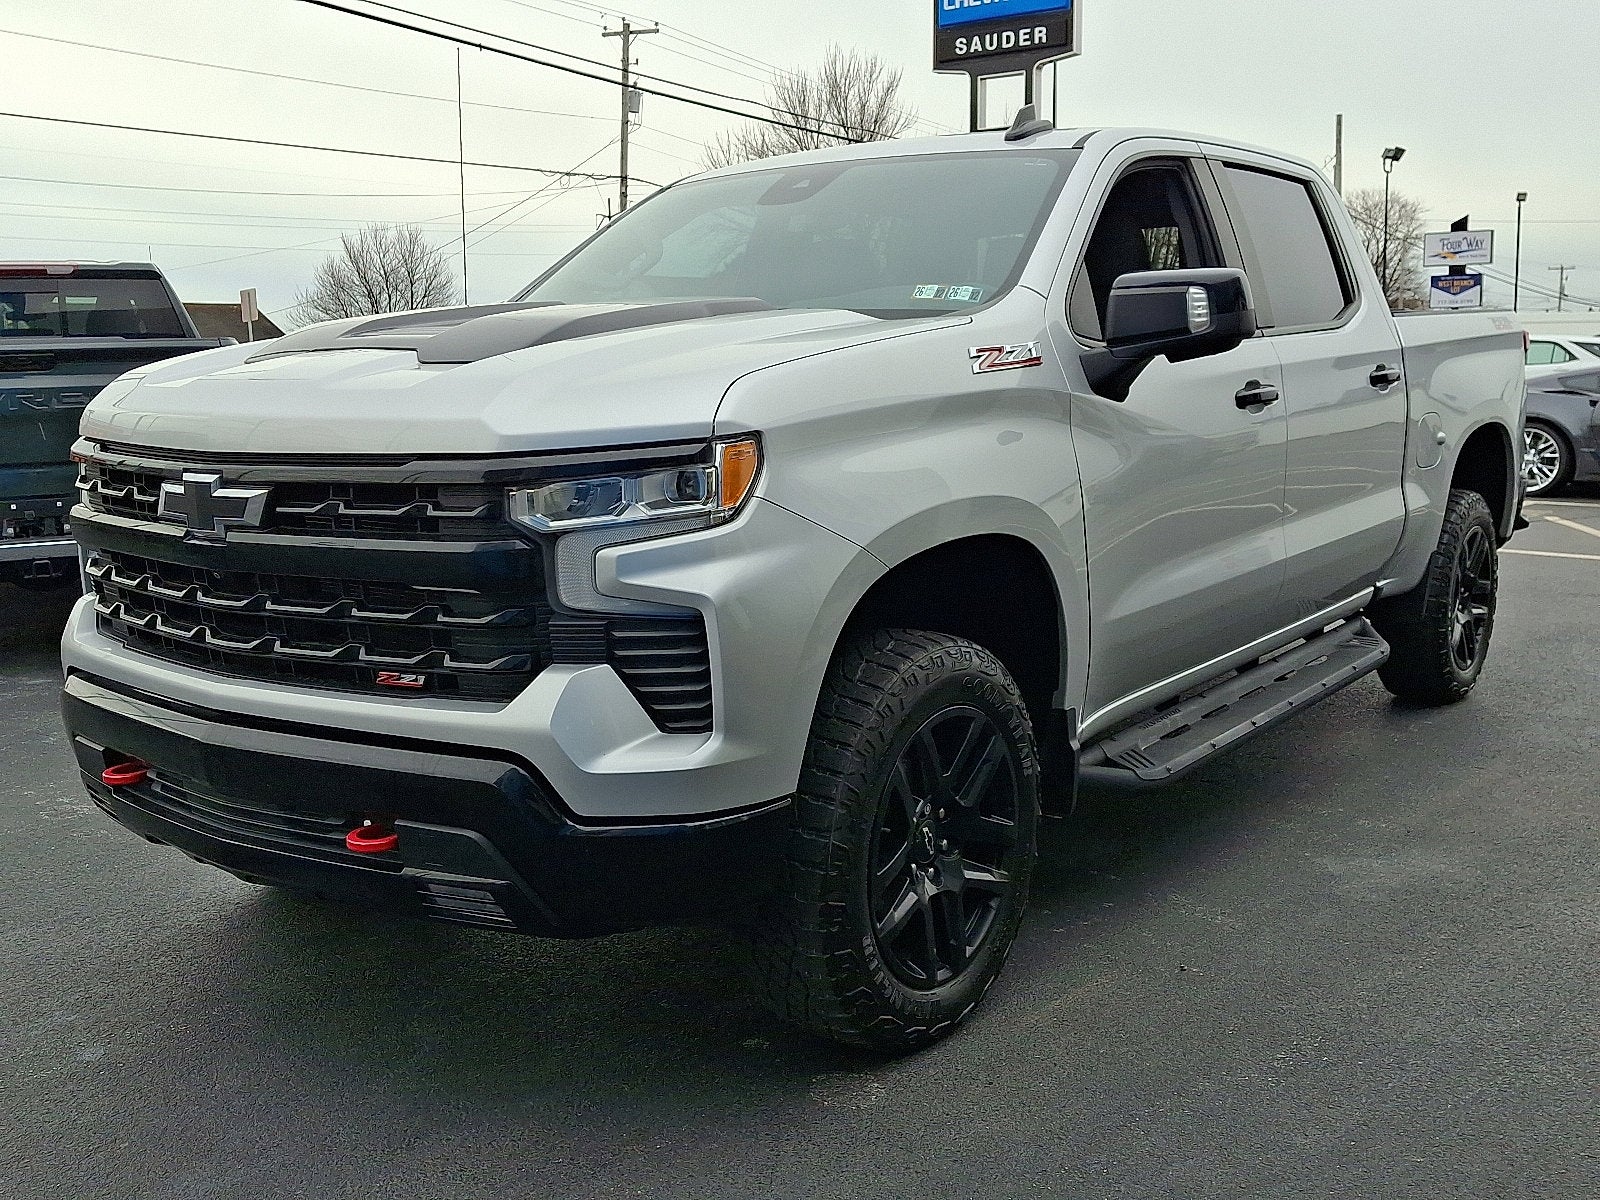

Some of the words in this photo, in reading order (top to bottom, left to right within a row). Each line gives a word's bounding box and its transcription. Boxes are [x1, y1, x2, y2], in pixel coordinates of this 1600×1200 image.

[954, 26, 1047, 55] SAUDER
[1439, 237, 1462, 251] FOUR
[1462, 235, 1485, 249] WAY
[915, 286, 925, 297] 26
[949, 287, 960, 298] 26
[968, 341, 1044, 375] Z71
[376, 672, 425, 687] Z71
